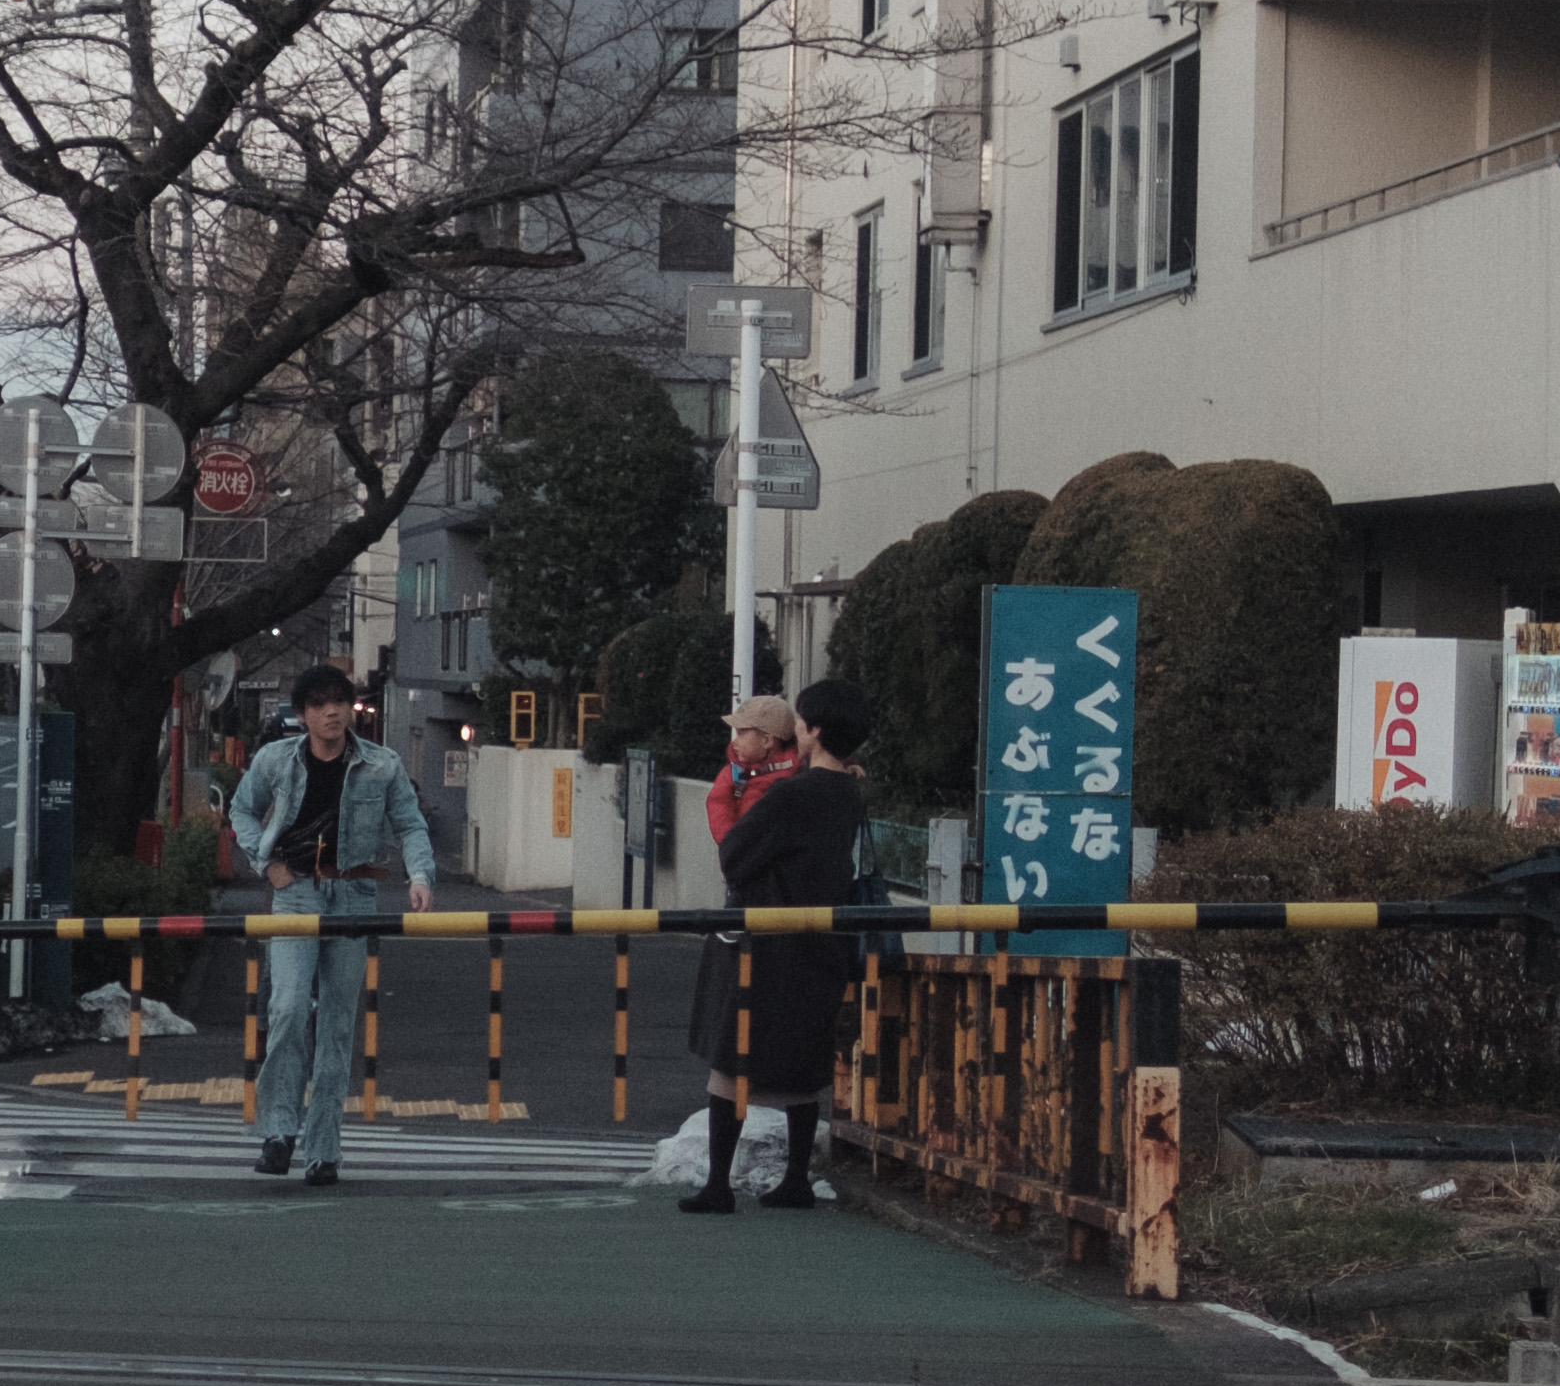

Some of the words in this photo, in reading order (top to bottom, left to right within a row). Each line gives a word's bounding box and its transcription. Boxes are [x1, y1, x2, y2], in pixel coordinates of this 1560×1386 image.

[200, 470, 249, 496] 消火栓
[1001, 657, 1055, 903] あぶない
[1070, 615, 1123, 861] くぐるな
